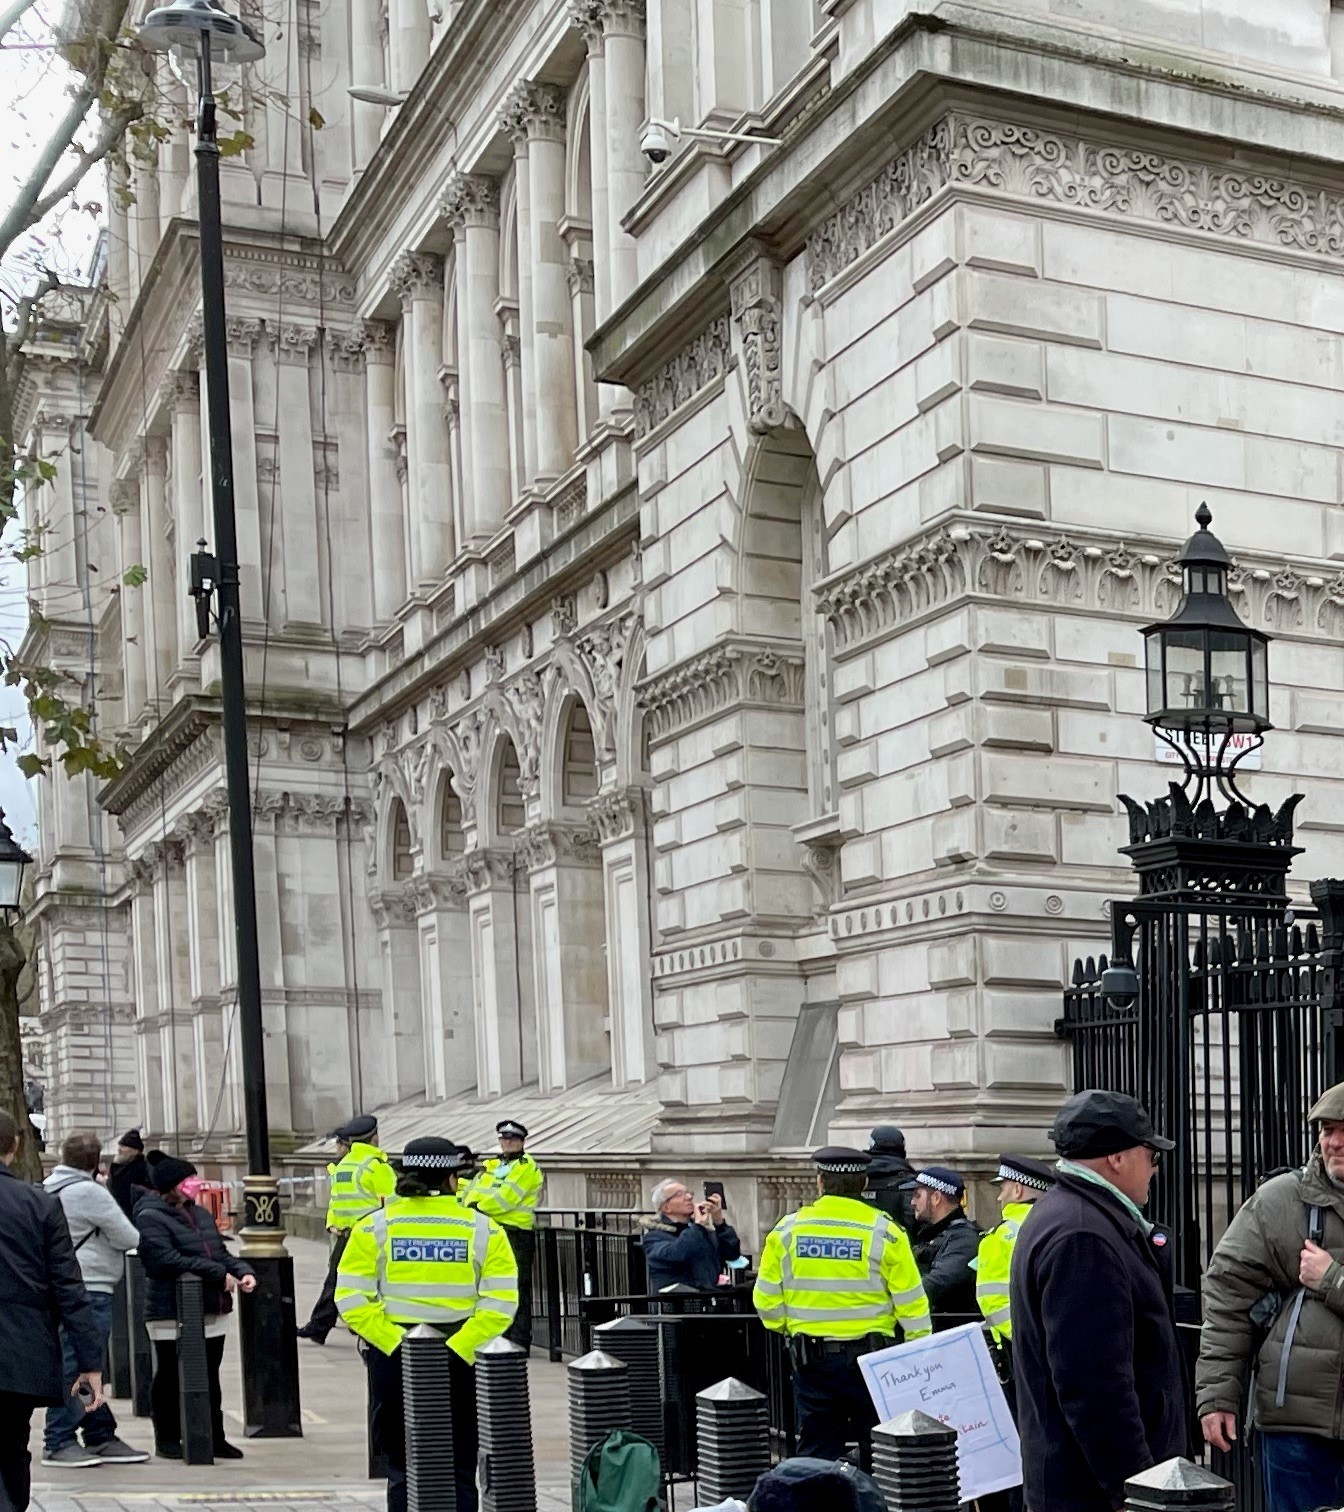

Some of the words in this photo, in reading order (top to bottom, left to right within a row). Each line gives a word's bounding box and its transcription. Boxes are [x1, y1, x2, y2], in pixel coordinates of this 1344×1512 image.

[392, 1239, 467, 1247] METROPOLITAN
[393, 1247, 467, 1261] POLICE
[797, 1244, 861, 1260] POLICE
[880, 1364, 923, 1388] Thank
[922, 1362, 943, 1383] you
[919, 1382, 957, 1402] Emma
